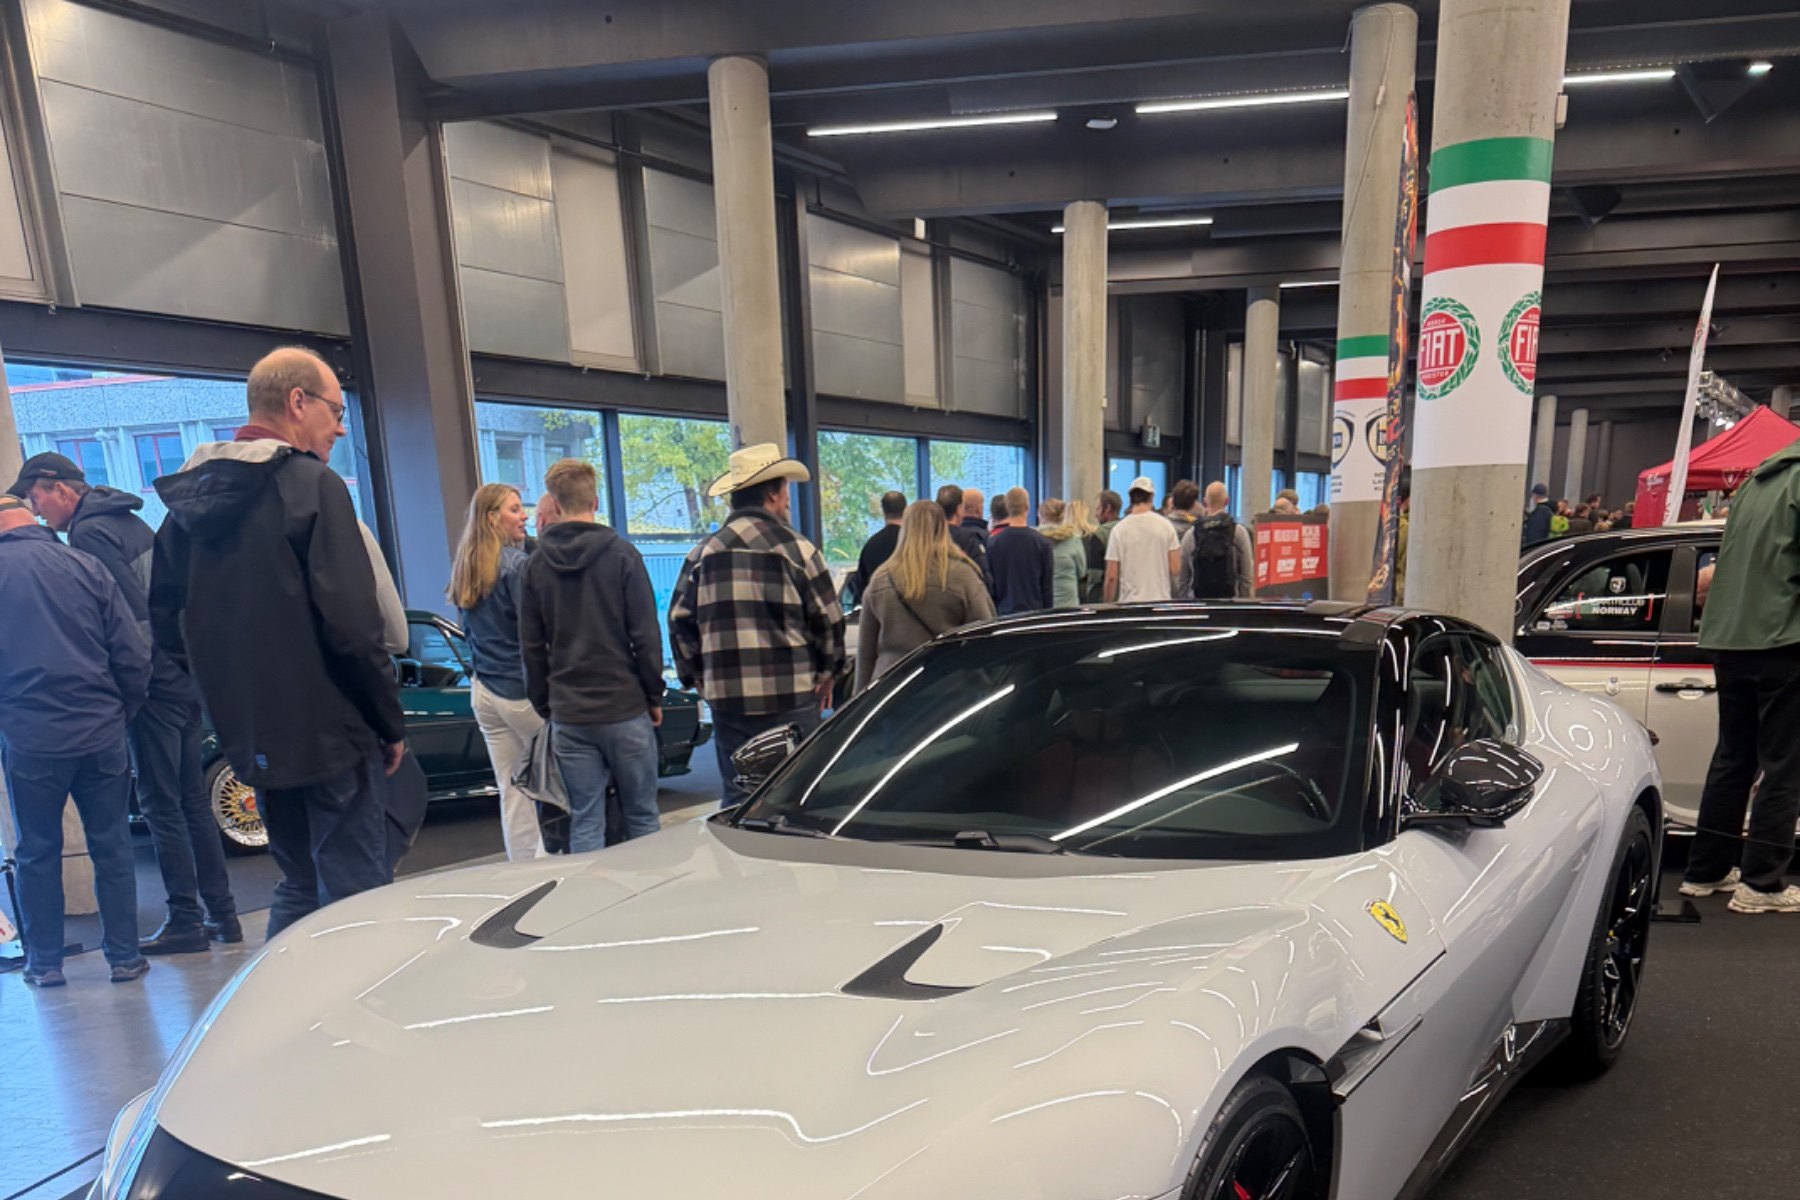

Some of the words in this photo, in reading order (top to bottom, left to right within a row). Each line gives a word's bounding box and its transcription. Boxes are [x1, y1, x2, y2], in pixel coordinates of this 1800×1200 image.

[1419, 328, 1461, 370] FIAT
[1515, 323, 1540, 363] FIA
[1591, 606, 1638, 616] NORWAY
